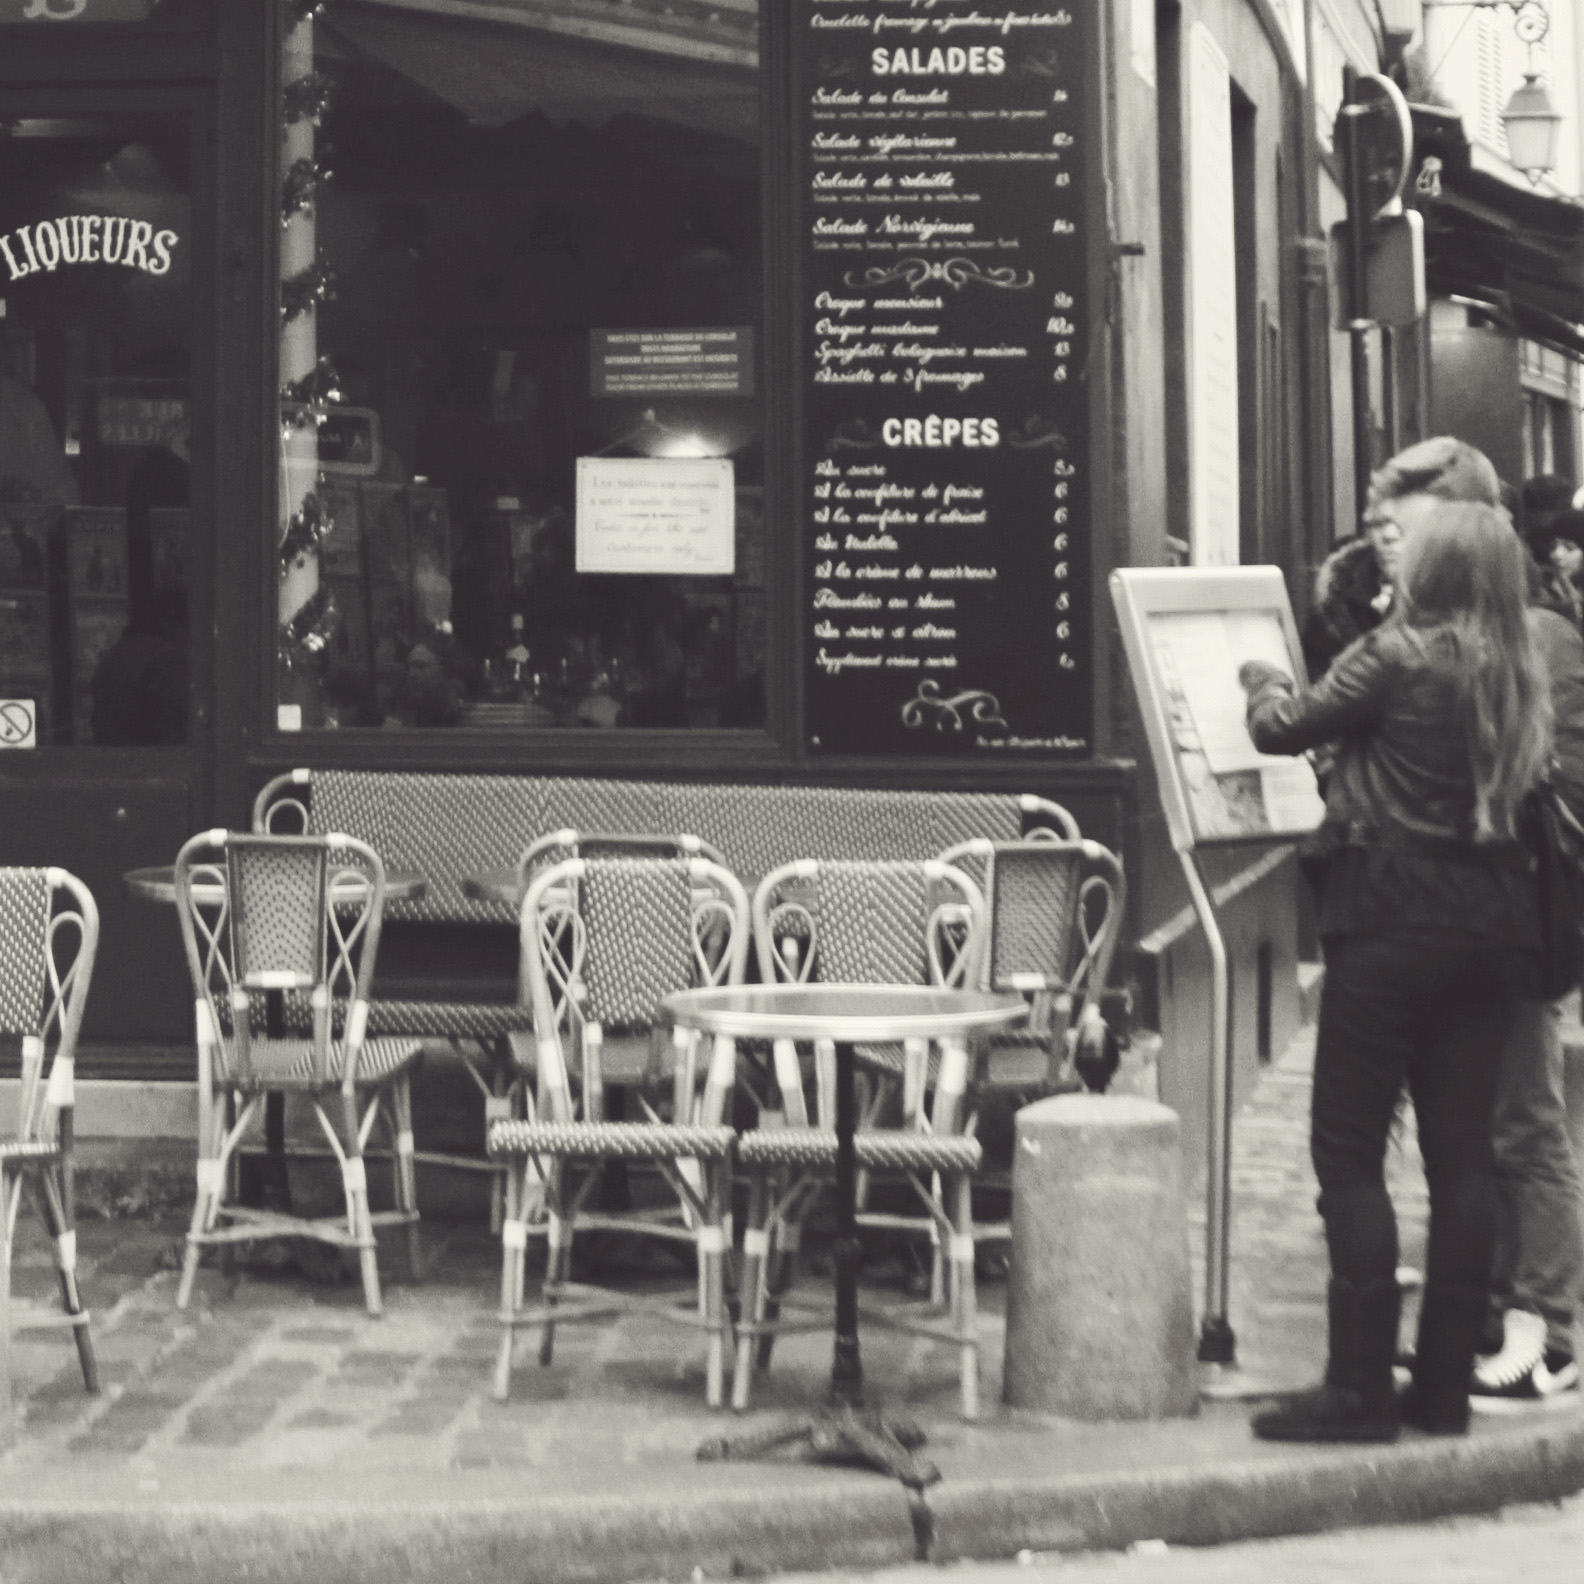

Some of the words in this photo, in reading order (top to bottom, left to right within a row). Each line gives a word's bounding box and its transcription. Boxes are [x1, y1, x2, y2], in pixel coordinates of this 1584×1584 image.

[811, 13, 870, 27] Omelette
[872, 46, 1006, 75] SALADES
[812, 87, 862, 104] Salade
[812, 132, 861, 148] Salade
[812, 171, 867, 188] Salade
[873, 173, 893, 187] de
[813, 217, 867, 234] Salade
[880, 369, 898, 383] de
[882, 413, 1000, 447] CRÊPES
[921, 483, 939, 498] de
[905, 563, 924, 579] de
